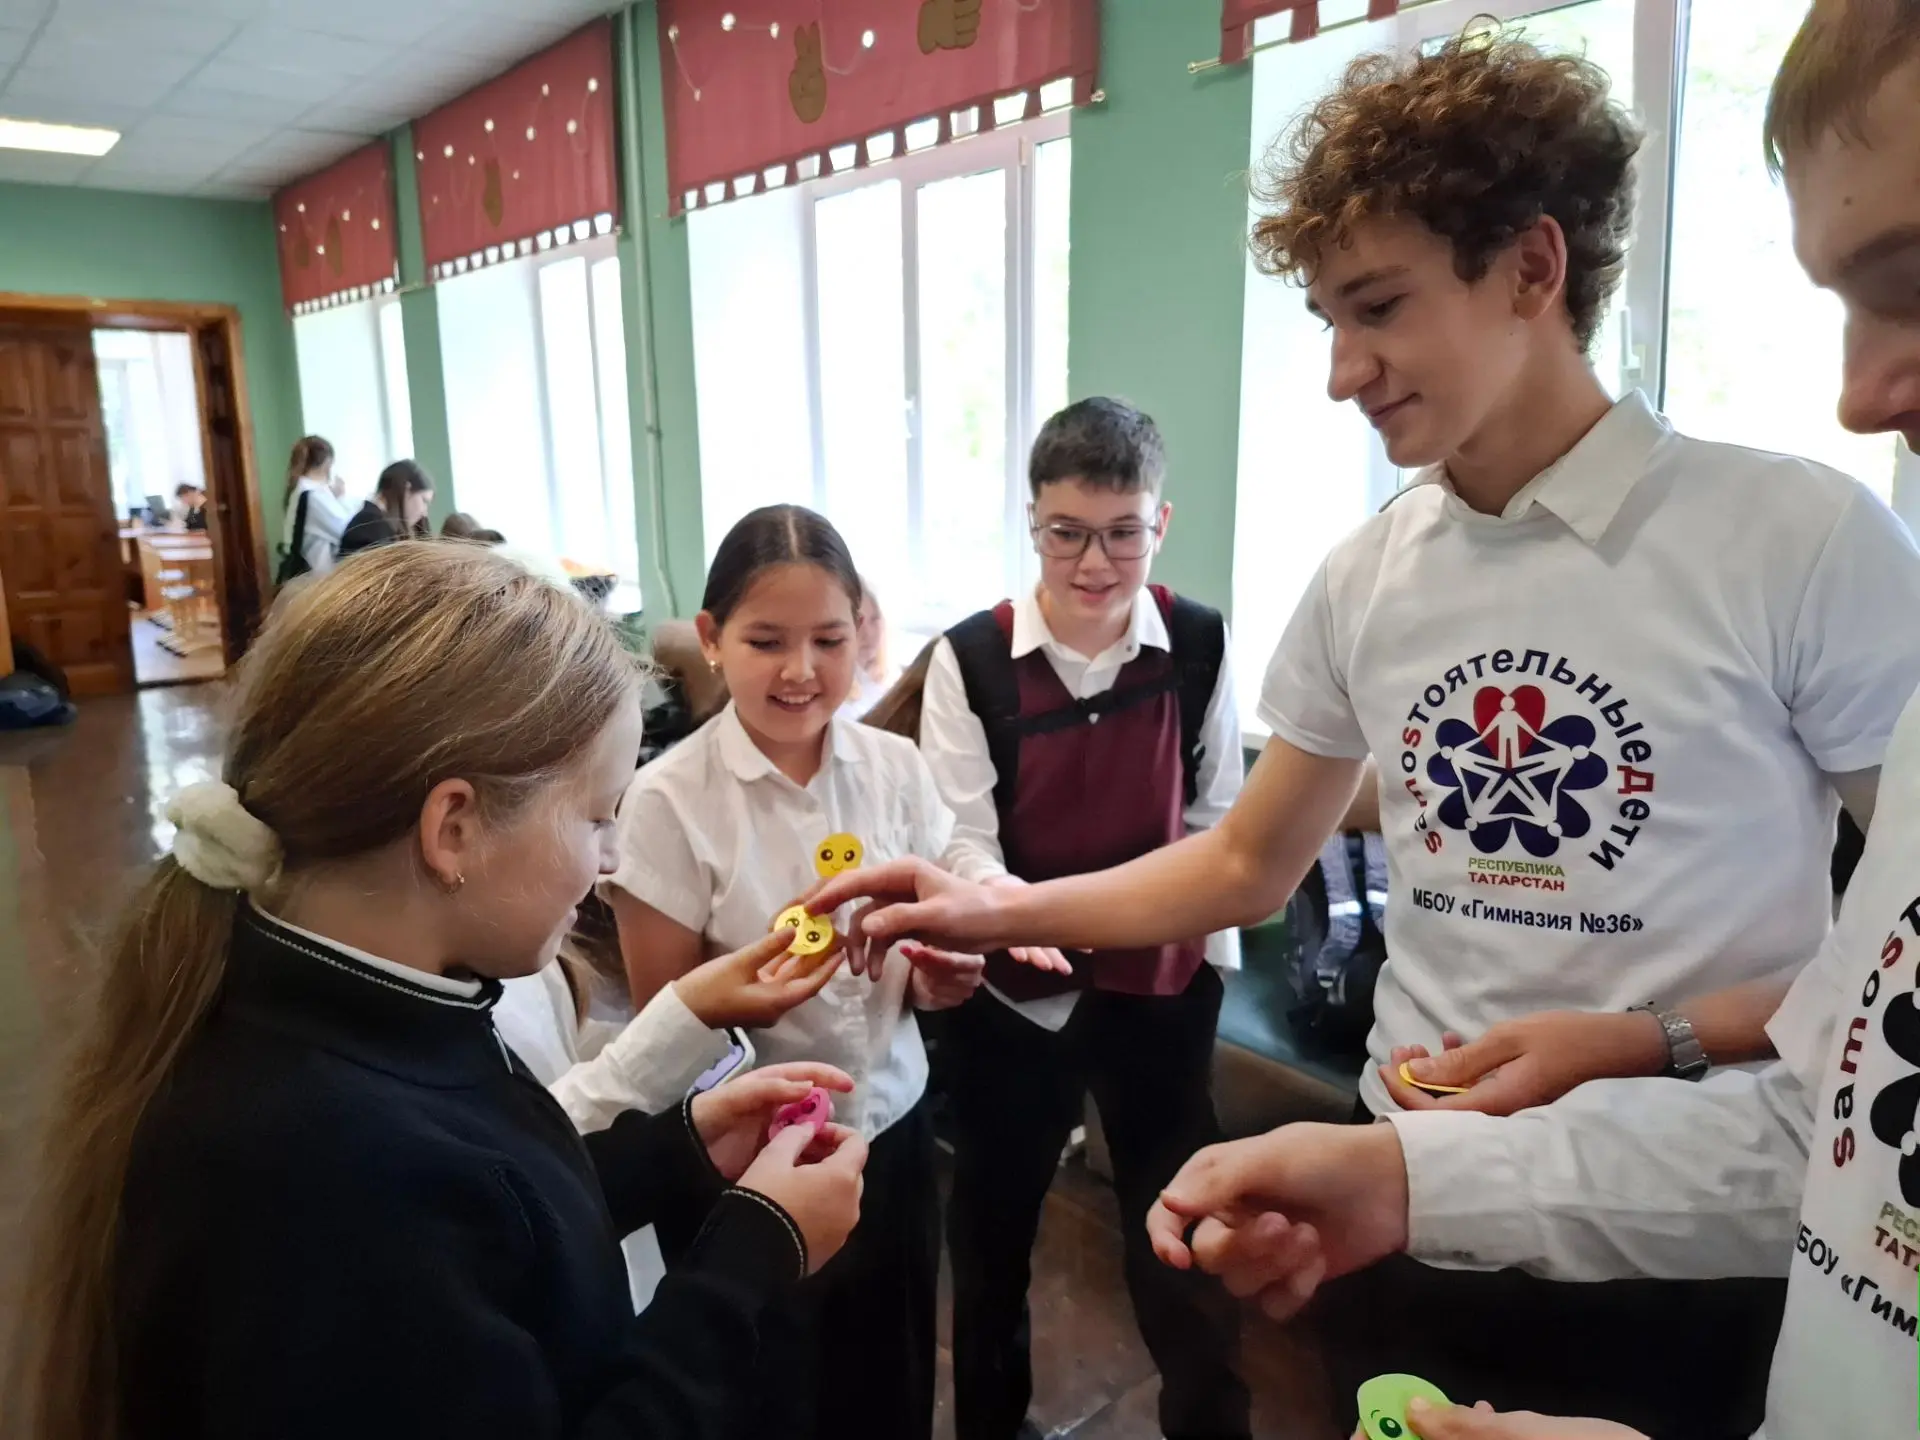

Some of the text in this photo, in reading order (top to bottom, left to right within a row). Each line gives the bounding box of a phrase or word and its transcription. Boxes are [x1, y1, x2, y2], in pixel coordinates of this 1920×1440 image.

[1468, 856, 1565, 877] РЕСПУБЛИКА
[1468, 871, 1565, 892] ТАТАРСТАН
[1412, 887, 1644, 934] МБОУ «Гимназия №36»
[1879, 1200, 1920, 1244] РЕС
[1796, 1219, 1920, 1343] БОУ «Гим
